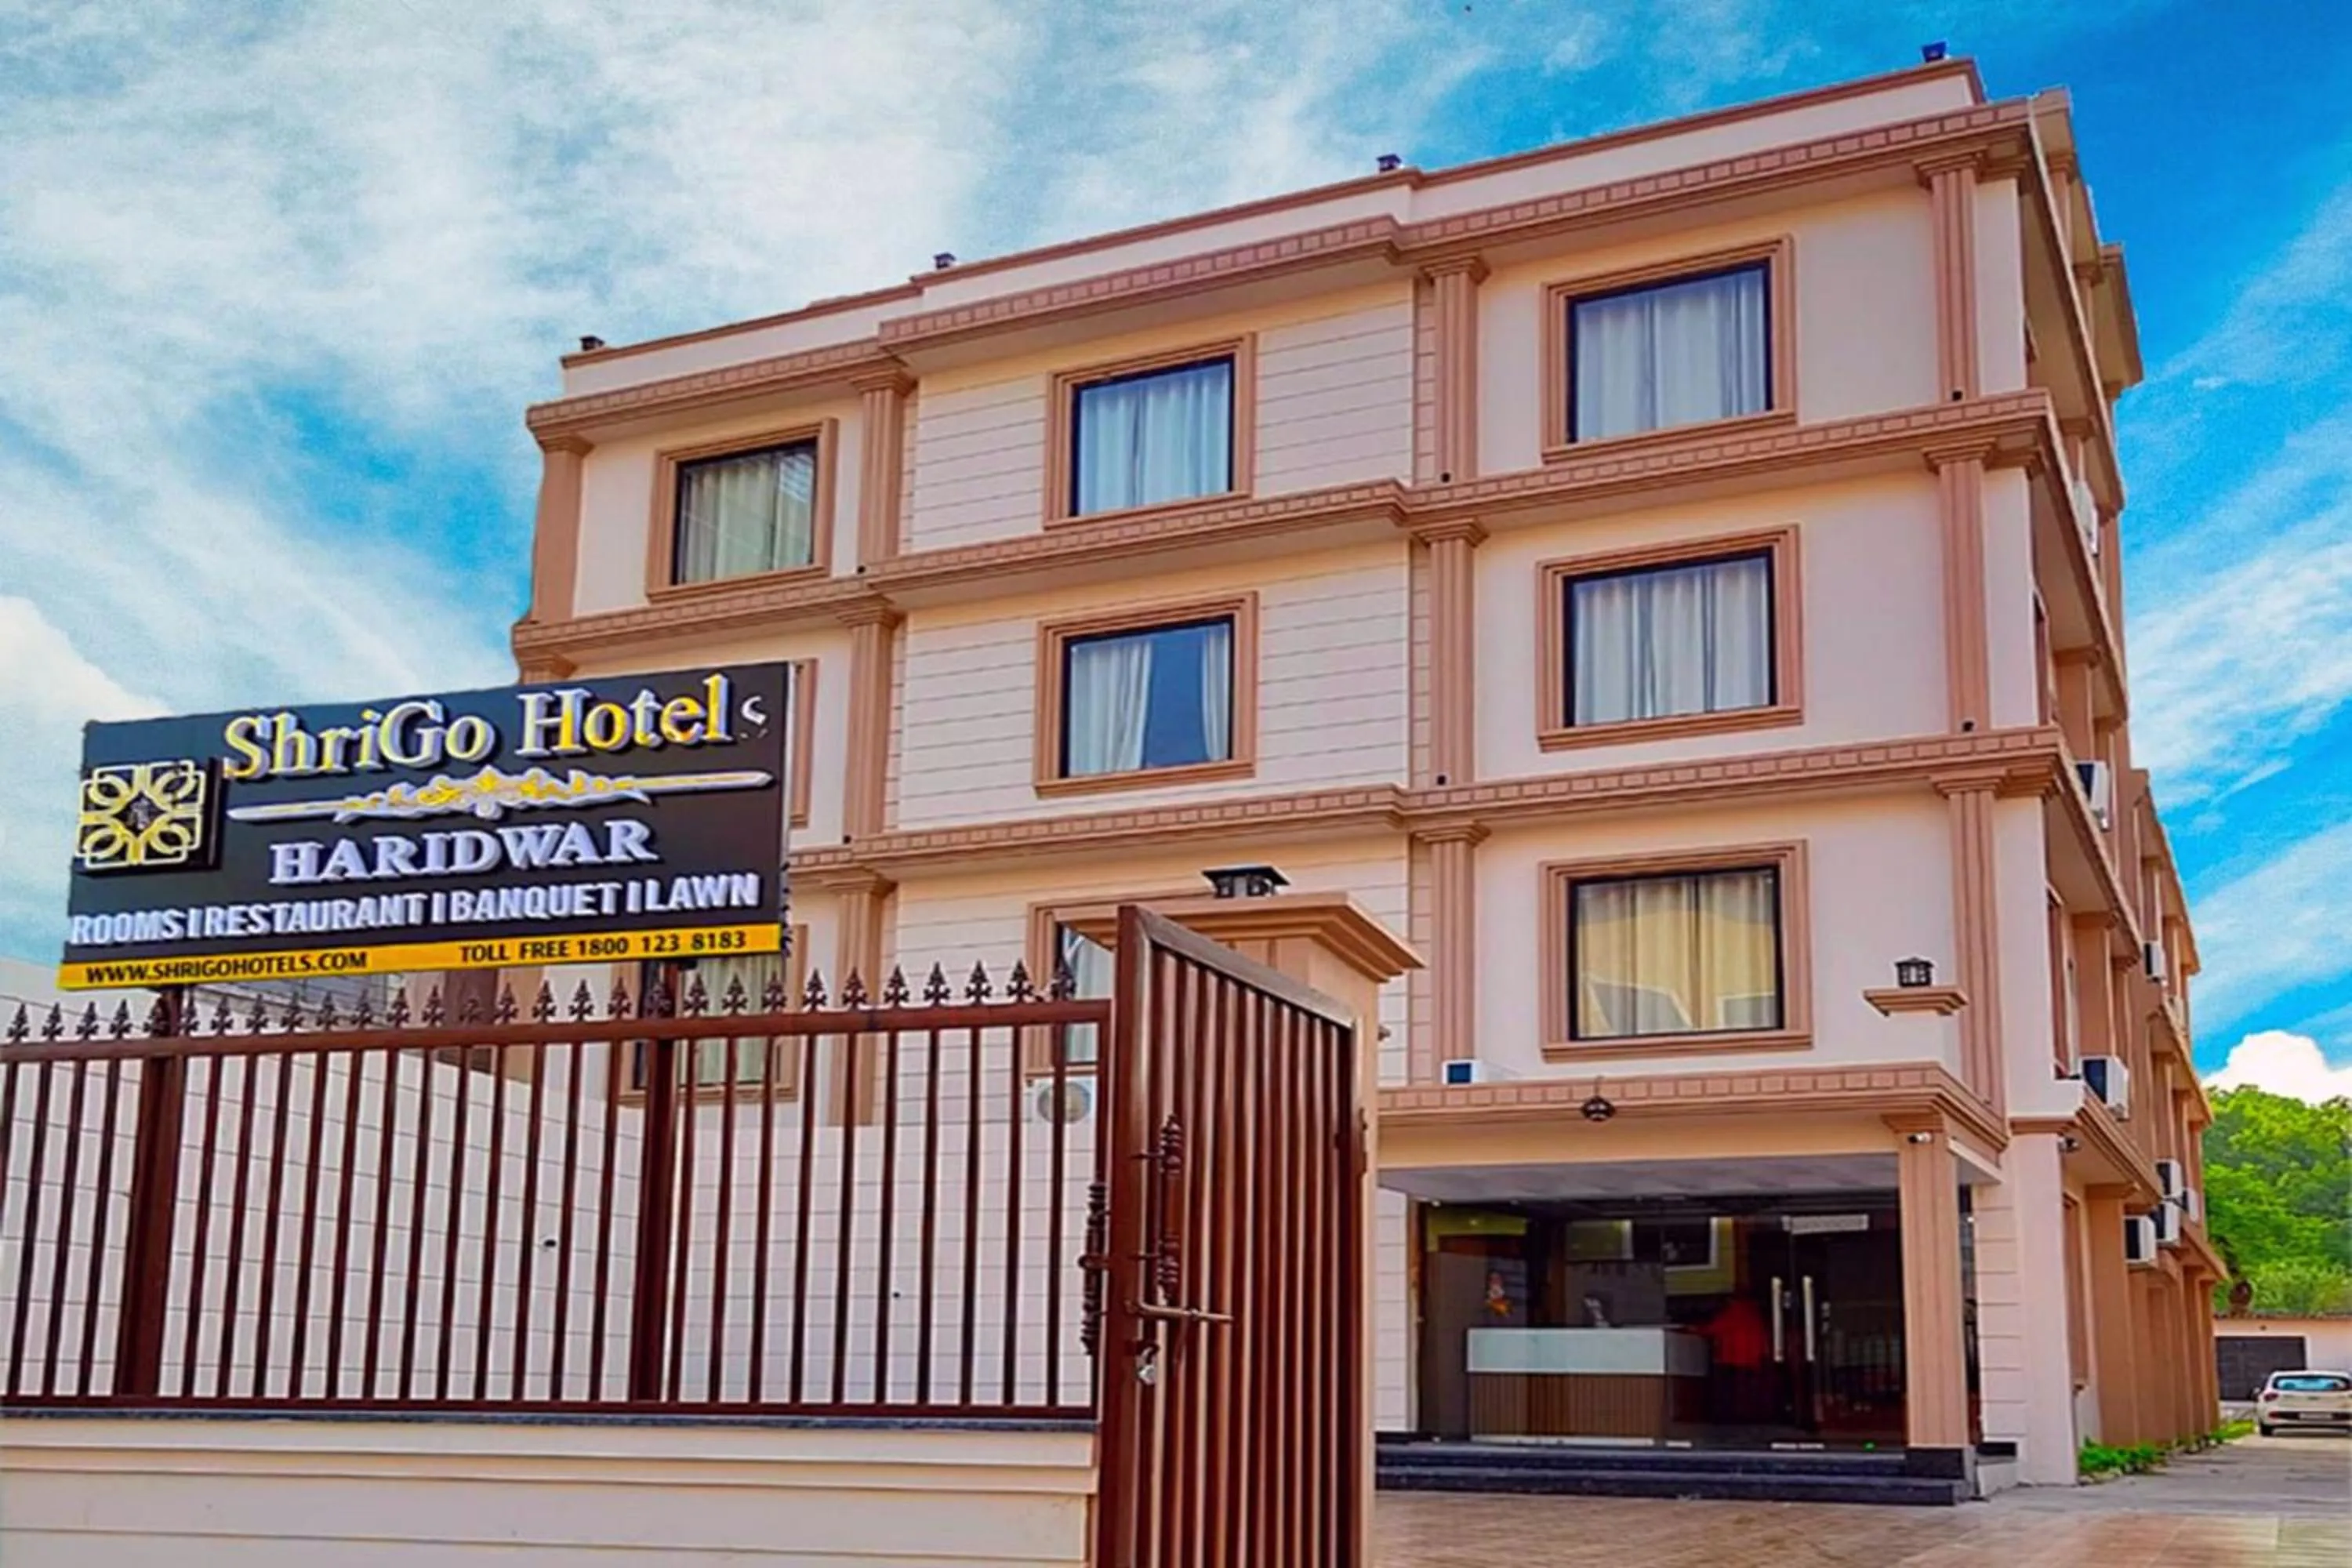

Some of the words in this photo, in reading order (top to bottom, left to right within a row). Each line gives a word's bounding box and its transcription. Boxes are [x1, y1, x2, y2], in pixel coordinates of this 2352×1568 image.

[223, 699, 496, 779] ShriGo
[267, 819, 659, 884] HARIDWAR
[70, 910, 184, 945] ROOMS
[201, 893, 428, 938] RESTAURANT
[449, 882, 622, 924] BANQUET
[644, 872, 760, 913] LAWN
[85, 951, 368, 983] WWW.SHRIGOHOTELS.COM
[459, 944, 510, 963] TOLL
[518, 941, 570, 960] FREE
[578, 936, 629, 956] 1800
[641, 934, 681, 953] 123
[689, 931, 746, 950] 8183
